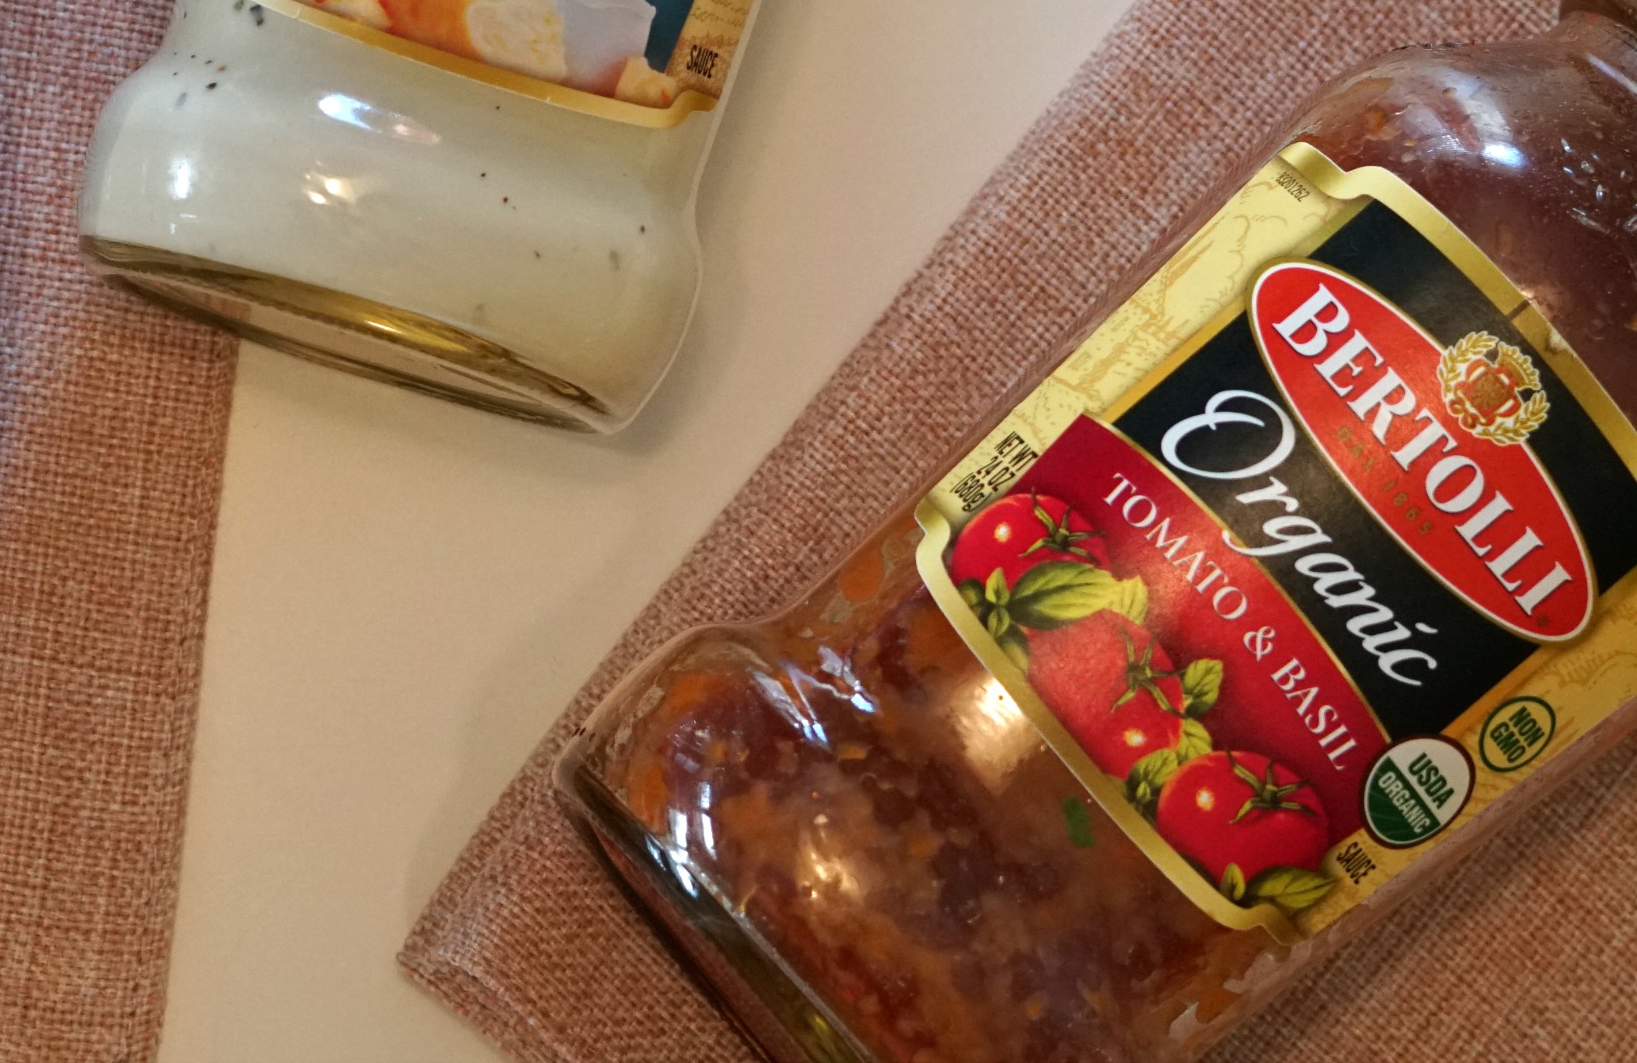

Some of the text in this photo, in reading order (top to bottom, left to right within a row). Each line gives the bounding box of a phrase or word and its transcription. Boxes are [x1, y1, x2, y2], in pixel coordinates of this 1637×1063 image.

[686, 44, 718, 79] SAUCE
[994, 430, 1039, 472] NET WT
[1272, 283, 1572, 615] BERTOLLI
[949, 472, 993, 512] (680g)
[976, 455, 1016, 492] 24 OZ
[1161, 389, 1438, 686] Organic
[1103, 473, 1357, 771] TOMATO & BASIL
[1490, 721, 1526, 764] GMO
[1509, 706, 1545, 747] NON
[1378, 771, 1431, 834] ORGANIC
[1407, 752, 1455, 810] USDA
[1336, 841, 1376, 885] SAUCE
